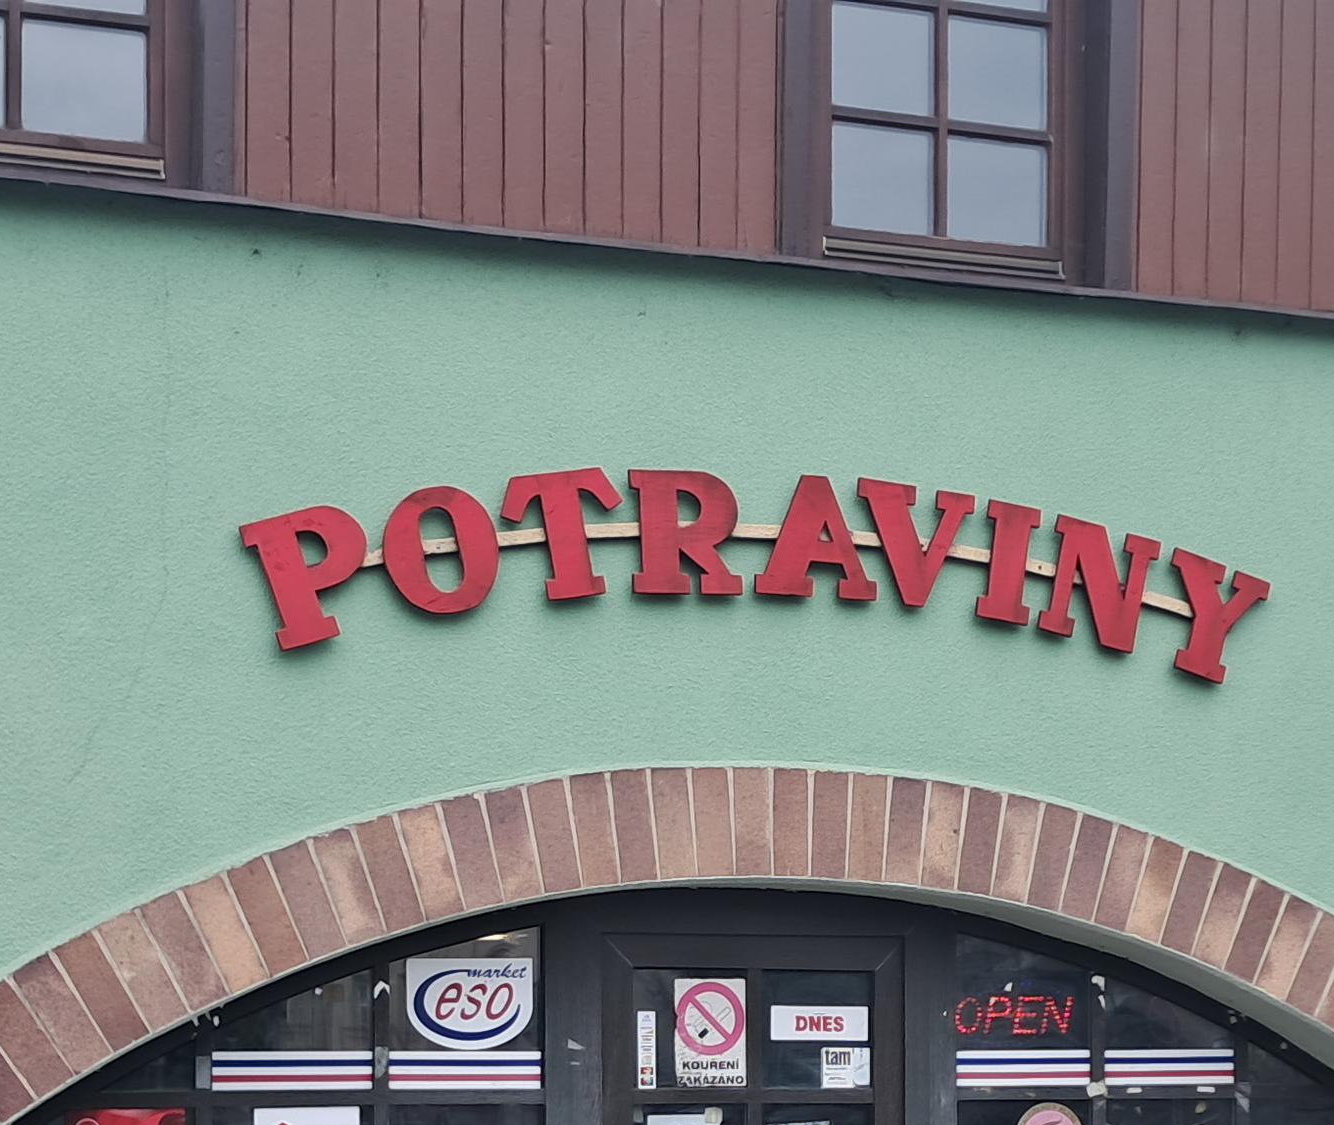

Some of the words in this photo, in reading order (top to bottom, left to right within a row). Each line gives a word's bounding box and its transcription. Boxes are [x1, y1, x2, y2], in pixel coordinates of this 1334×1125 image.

[237, 467, 1271, 684] POTRAVINY
[466, 963, 527, 978] market
[435, 982, 514, 1020] eso
[955, 996, 1075, 1035] OPEN
[795, 1015, 845, 1032] DNES
